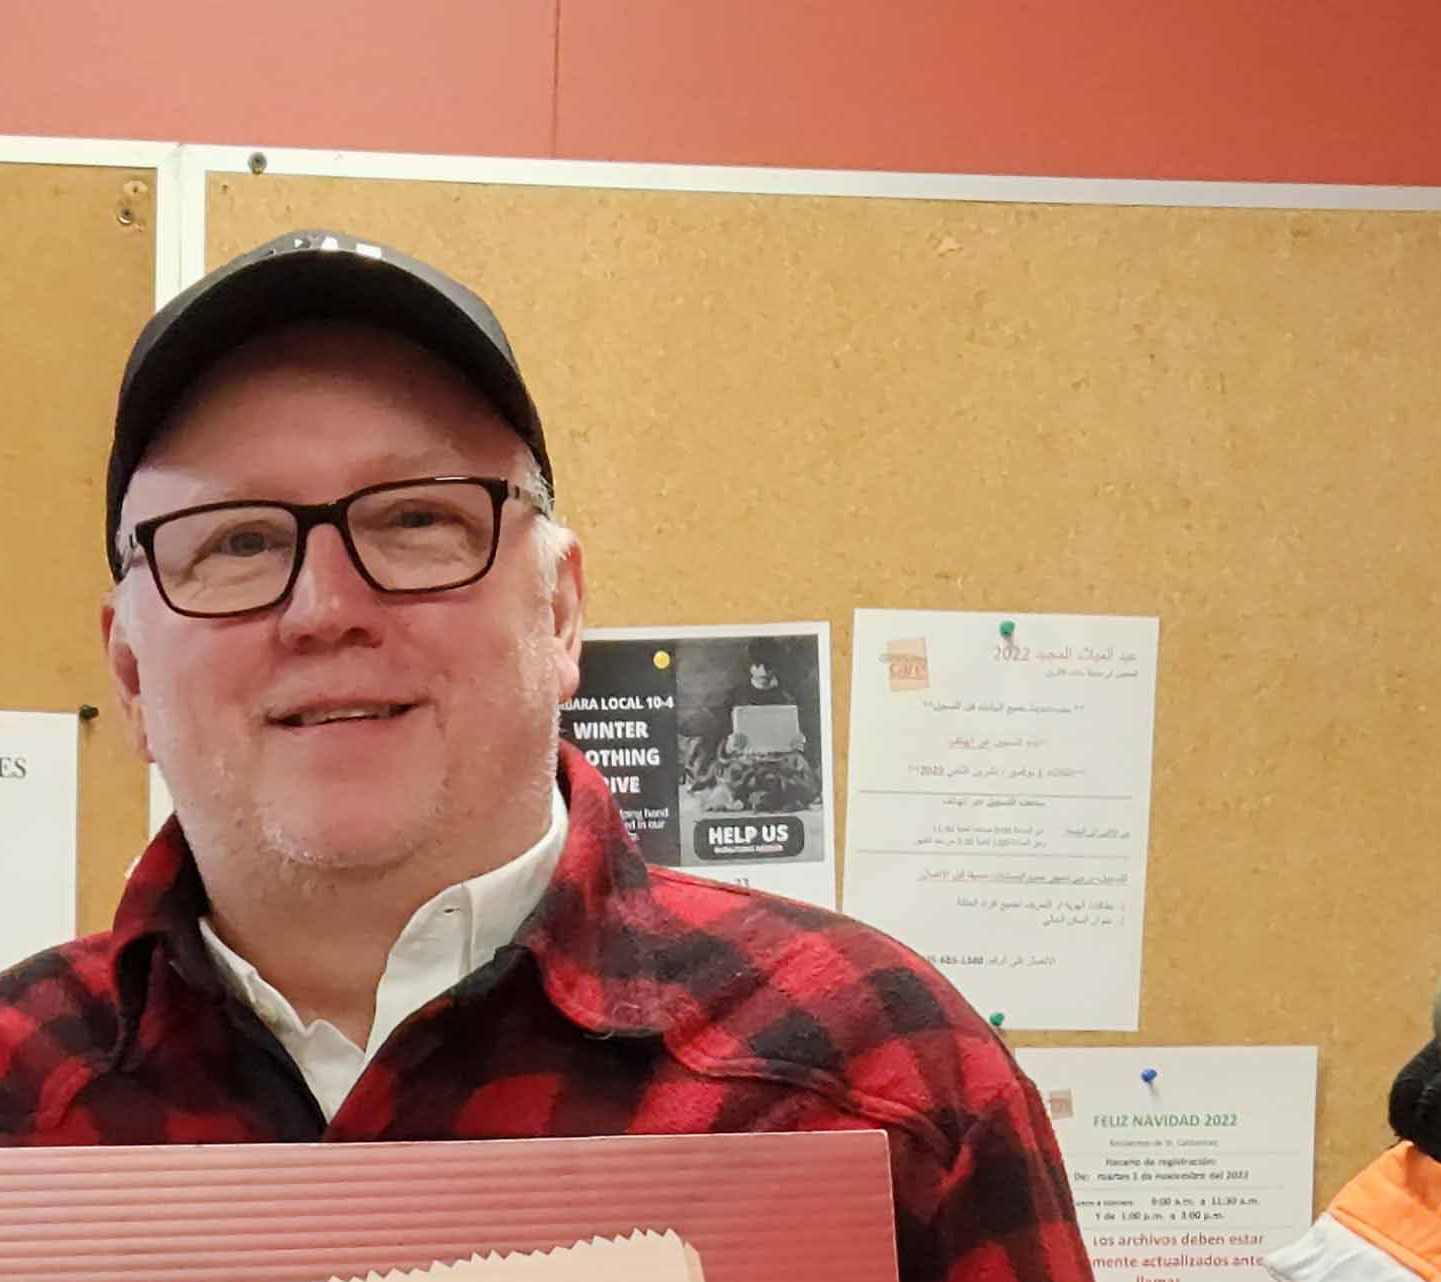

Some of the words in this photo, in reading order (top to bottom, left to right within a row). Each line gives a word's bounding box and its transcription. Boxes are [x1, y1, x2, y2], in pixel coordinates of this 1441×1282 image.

[601, 697, 644, 711] LOCAL
[646, 695, 674, 710] 10-4
[573, 721, 649, 740] WINTER
[585, 749, 660, 767] OTHING
[604, 776, 641, 794] IVE
[708, 826, 758, 846] HELP
[762, 824, 789, 842] US
[1094, 1115, 1128, 1128] FELIZ
[1132, 1114, 1200, 1127] NAVIDAD
[1204, 1114, 1237, 1127] 2022
[1118, 1232, 1177, 1247] archivos
[1181, 1232, 1225, 1246] deben
[1228, 1234, 1265, 1246] estar
[1092, 1255, 1140, 1269] mente
[1142, 1254, 1229, 1268] actualizados
[1232, 1255, 1264, 1267] ante
